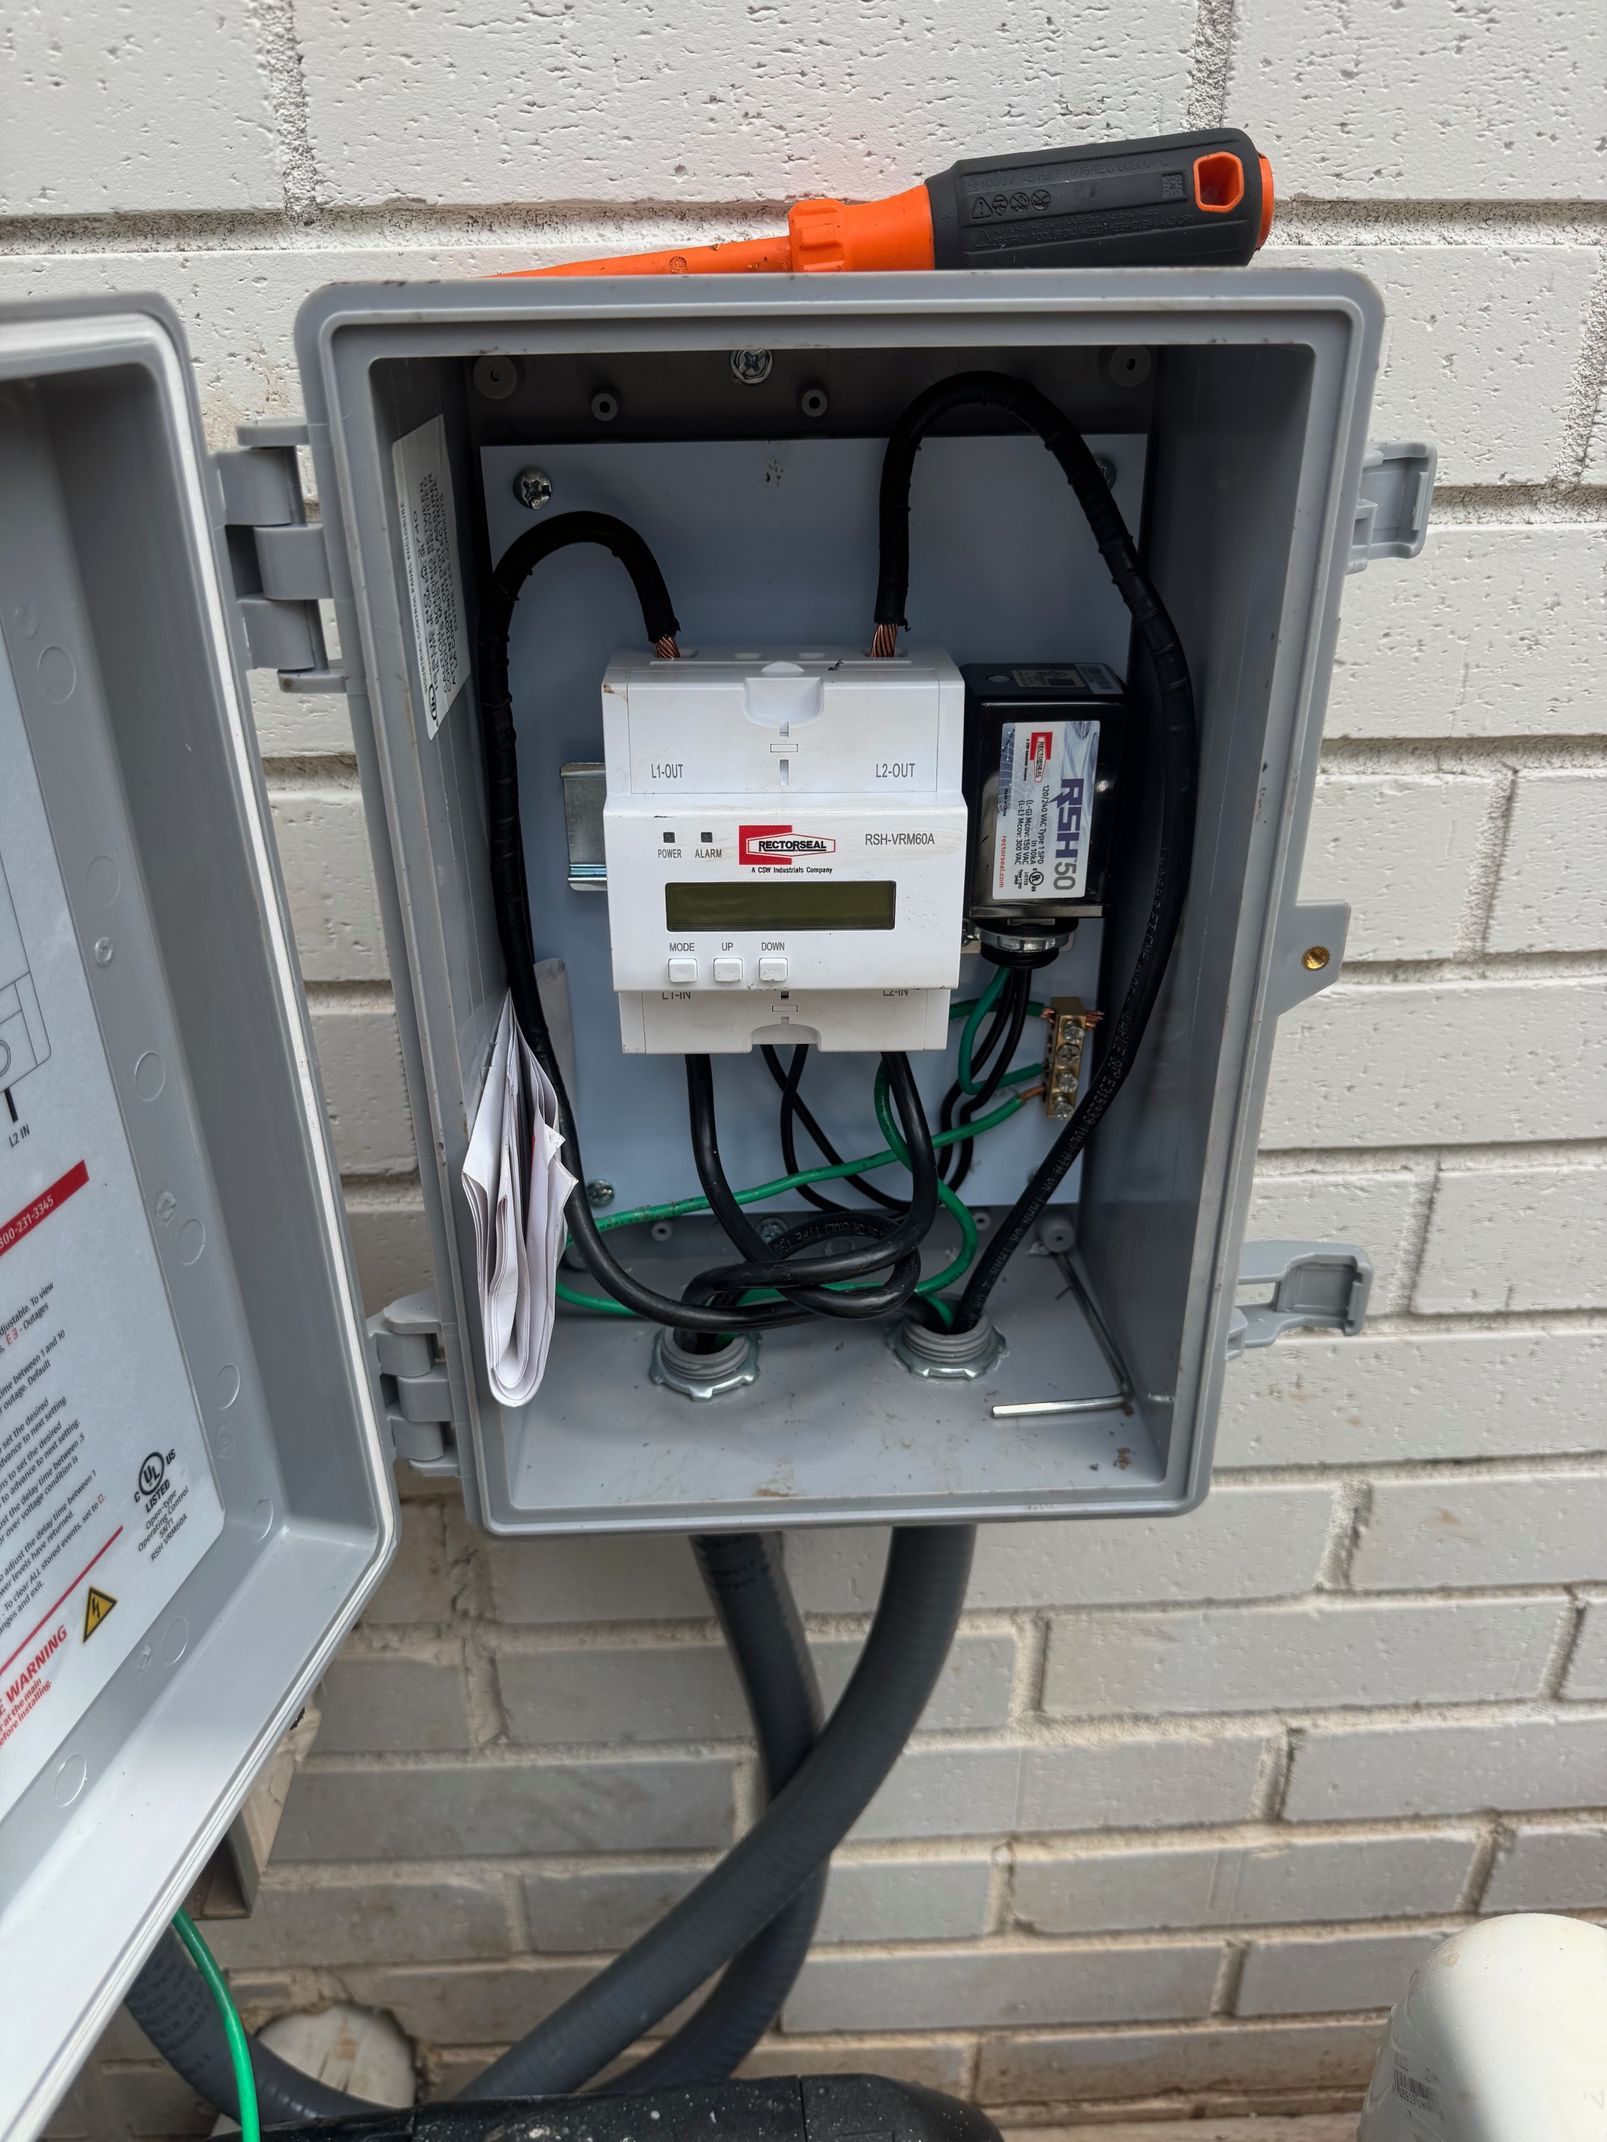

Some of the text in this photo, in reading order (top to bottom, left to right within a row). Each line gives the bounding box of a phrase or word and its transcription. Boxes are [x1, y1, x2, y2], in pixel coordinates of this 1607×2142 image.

[651, 763, 684, 779] L1-OUT
[875, 762, 916, 778] L2-OUT
[1035, 740, 1045, 778] RECTORSEAL
[1041, 784, 1050, 812] 120/240
[1016, 816, 1025, 838] Mcov:
[1024, 816, 1032, 837] Mcov:
[1040, 813, 1048, 828] VAC
[758, 839, 827, 853] RECTORSEAL
[865, 833, 935, 846] RSH-VRM60A
[1015, 838, 1023, 852] 300
[1023, 838, 1031, 852] 150
[1038, 828, 1047, 844] Type
[1053, 778, 1084, 891] RSH 50
[657, 848, 682, 859] POWER
[694, 848, 722, 859] ALARM
[999, 835, 1007, 888] rectorseal.com
[1014, 852, 1022, 865] VAC
[1022, 852, 1030, 865] VAC
[1029, 848, 1037, 865] 10kA
[1037, 850, 1045, 864] SPD
[757, 866, 771, 874] CSW
[773, 866, 804, 874] Industrials
[806, 866, 833, 875] Company
[669, 942, 695, 952] MODE
[721, 942, 734, 952] UP
[761, 941, 785, 951] DOWN
[661, 991, 692, 1000] L1-IN
[9, 1124, 31, 1148] L2 IN
[30, 1295, 40, 1307] To
[39, 1282, 54, 1301] view
[23, 1302, 49, 1330] Outages
[13, 1354, 41, 1385] between
[46, 1335, 58, 1353] and
[4, 1359, 51, 1410] outage. Default
[3, 1398, 50, 1450] set the desired
[23, 1433, 31, 1444] to
[31, 1415, 45, 1436] next
[44, 1396, 69, 1424] setting.
[1, 1418, 81, 1504] to advance to next setting.
[8, 1420, 62, 1481] to set the desired
[165, 1448, 177, 1466] US
[9, 1502, 21, 1518] the
[21, 1483, 39, 1505] delay
[39, 1468, 53, 1486] time
[53, 1439, 80, 1471] between
[6, 1455, 79, 1537] over voltage condition is
[145, 1479, 171, 1514] LISTED
[137, 1485, 190, 1552] Operating Control
[145, 1490, 177, 1530] Open-type
[4, 1549, 25, 1576] adjust
[24, 1538, 36, 1553] the
[36, 1517, 54, 1541] delay
[53, 1501, 68, 1521] time
[67, 1474, 93, 1505] between
[150, 1513, 189, 1562] RSH VRM60A
[4, 1600, 13, 1612] To
[13, 1581, 29, 1602] clear
[29, 1567, 41, 1584] ALL
[41, 1541, 62, 1571] stored
[82, 1508, 94, 1525] set
[93, 1501, 100, 1512] to
[11, 1558, 31, 1582] levels
[31, 1540, 47, 1560] have
[46, 1511, 75, 1544] returned.
[17, 1593, 30, 1612] and
[30, 1580, 45, 1597] exit.
[6, 1624, 68, 1703] WARNING
[3, 1714, 12, 1728] at
[11, 1699, 24, 1716] the
[24, 1678, 42, 1701] main
[18, 1679, 52, 1722] installing.
